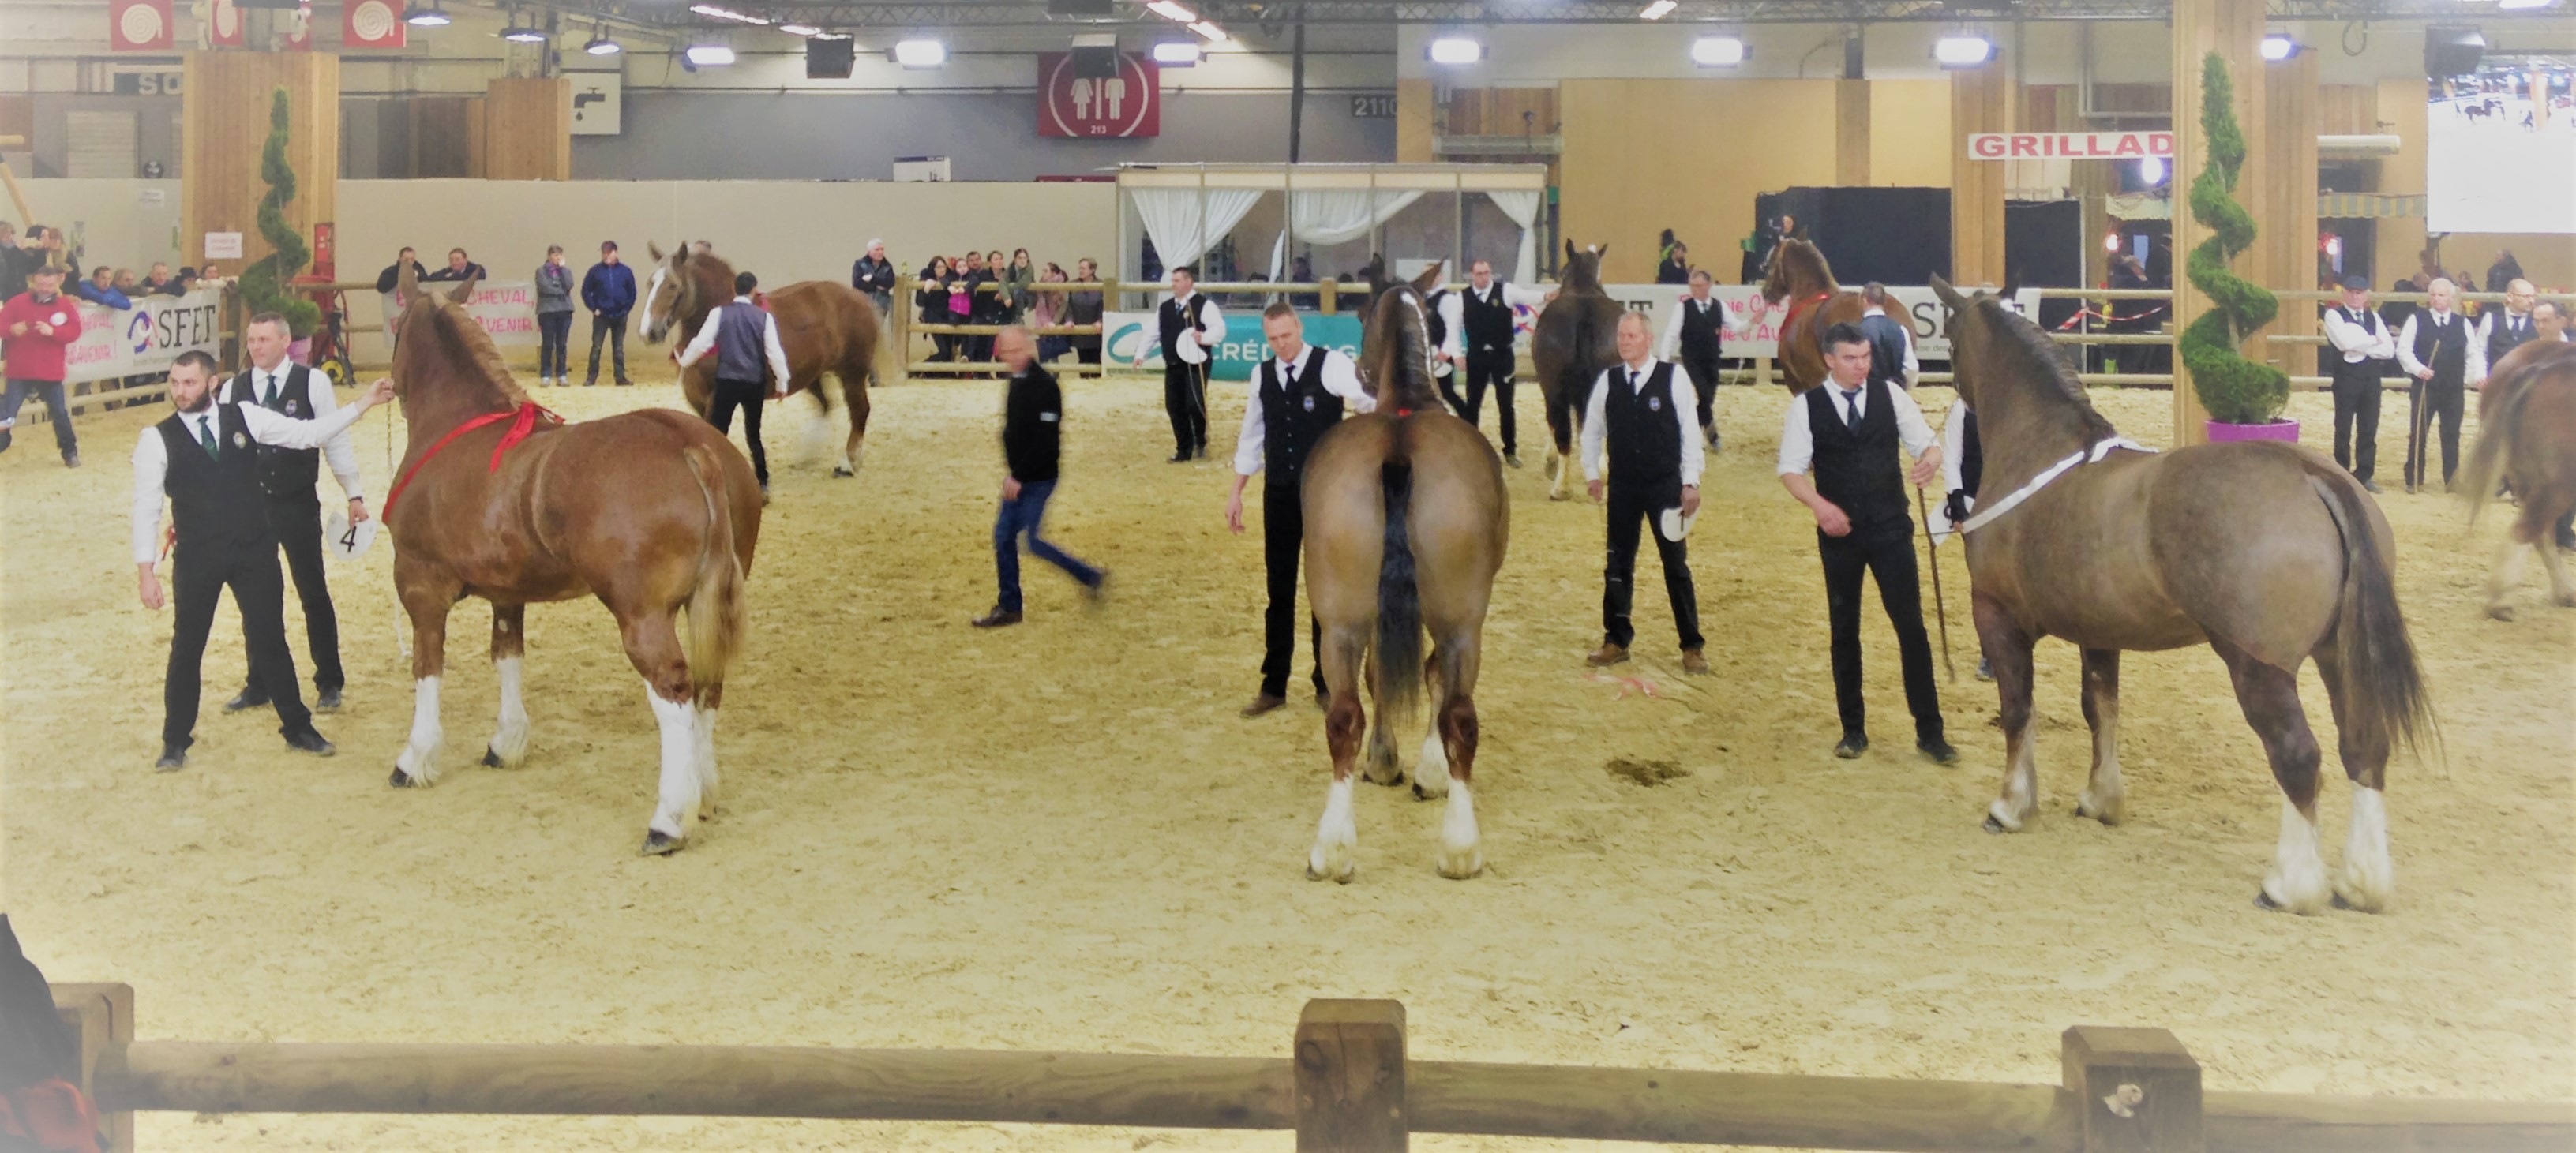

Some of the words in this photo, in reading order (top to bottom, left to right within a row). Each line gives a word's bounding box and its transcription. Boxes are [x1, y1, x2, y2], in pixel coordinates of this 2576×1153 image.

[1090, 125, 1107, 134] 213
[1974, 134, 2173, 156] GRILLAD
[159, 305, 216, 348] SFET
[339, 525, 357, 552] 4
